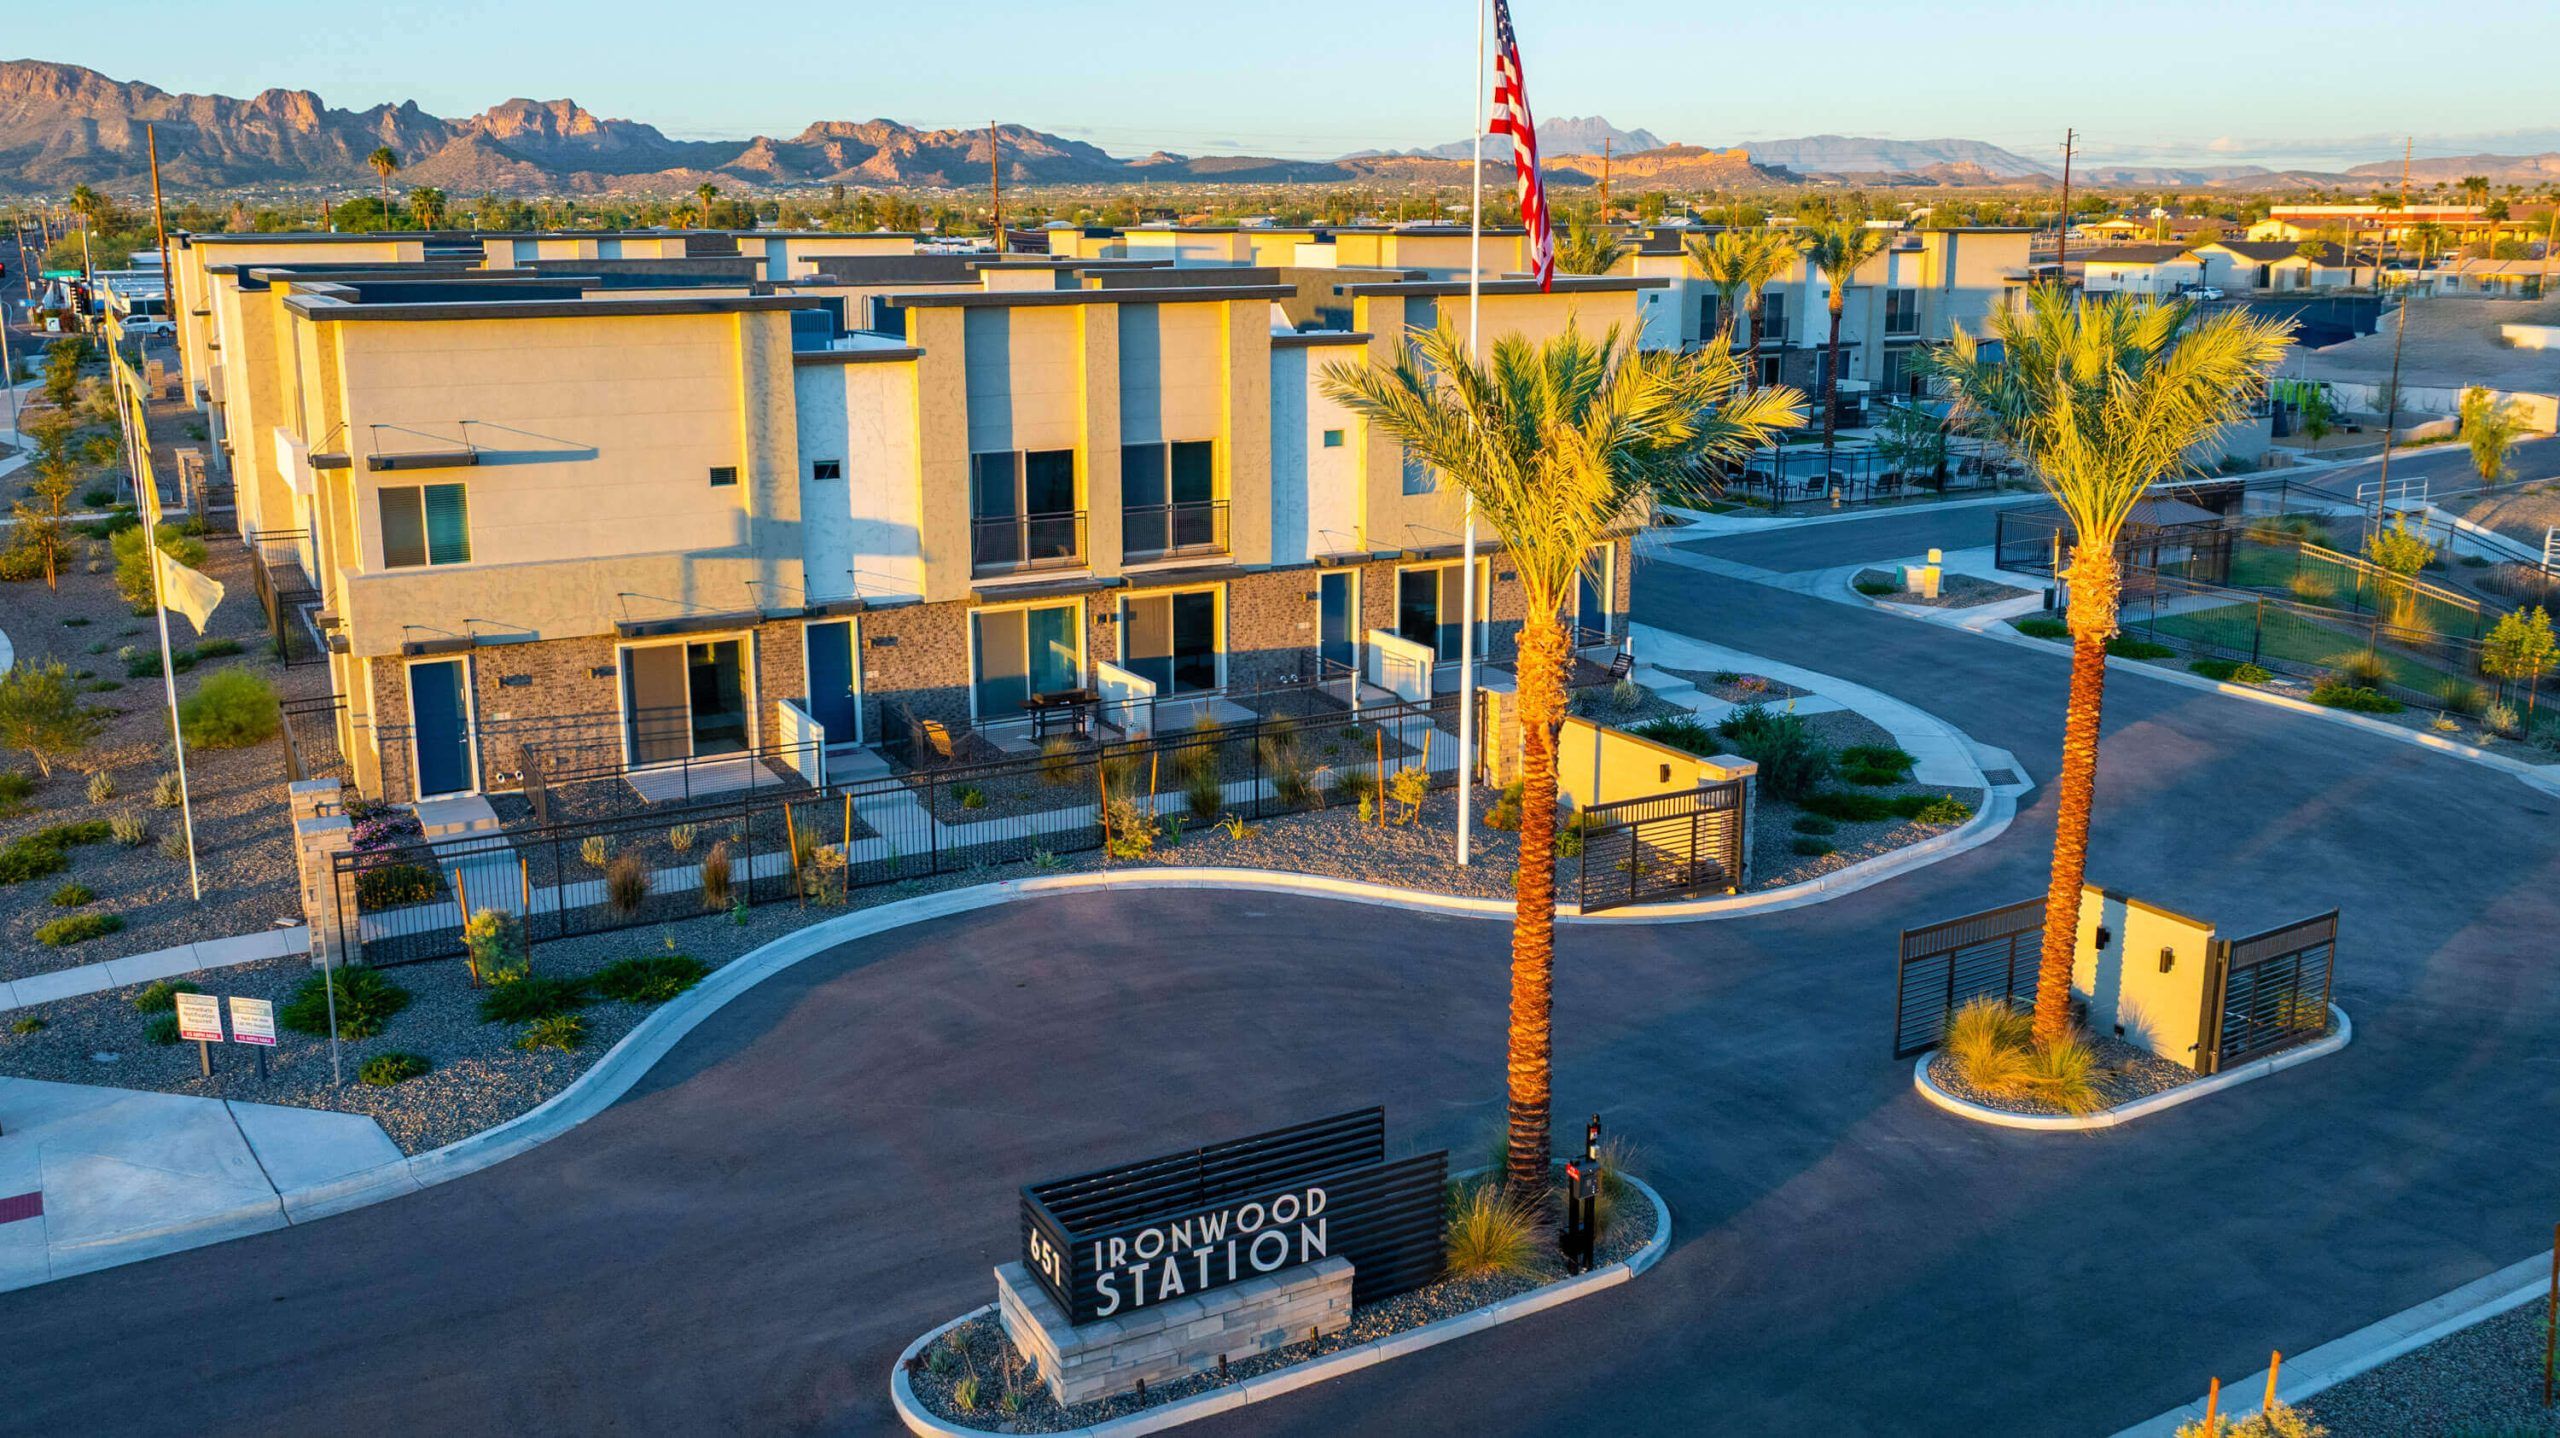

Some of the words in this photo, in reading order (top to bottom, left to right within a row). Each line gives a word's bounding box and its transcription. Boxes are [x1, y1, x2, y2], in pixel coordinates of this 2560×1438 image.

[1030, 1228, 1061, 1287] 651
[1095, 1187, 1327, 1271] IRONWOOD
[1096, 1217, 1327, 1317] STATION
